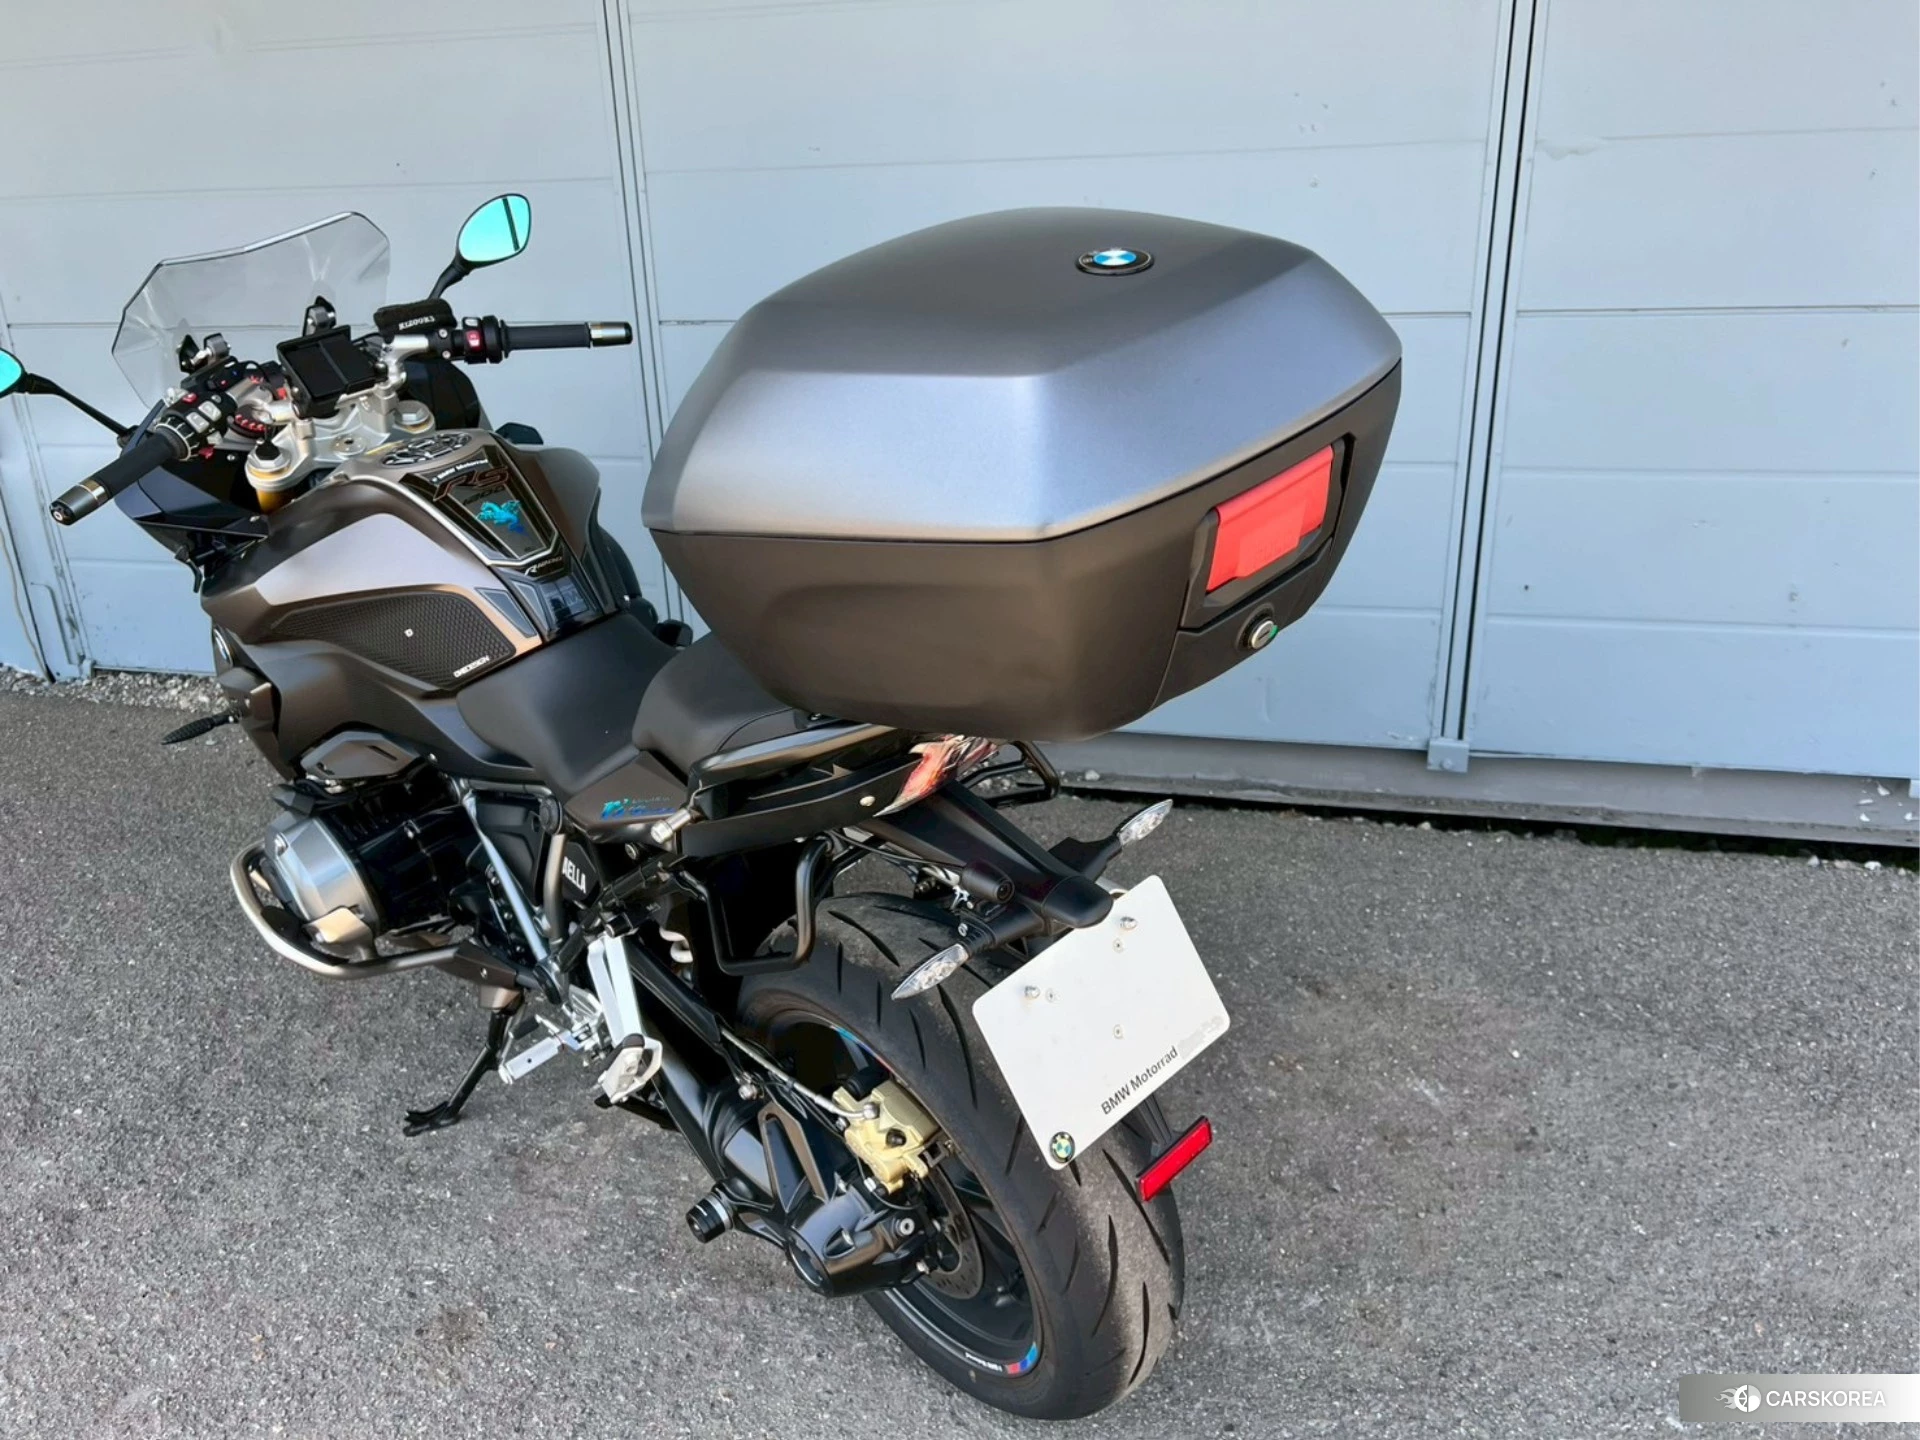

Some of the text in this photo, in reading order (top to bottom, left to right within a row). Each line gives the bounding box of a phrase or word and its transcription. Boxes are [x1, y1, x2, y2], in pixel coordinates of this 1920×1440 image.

[432, 465, 509, 502] RS
[1100, 1045, 1178, 1115] BMW Motorrad
